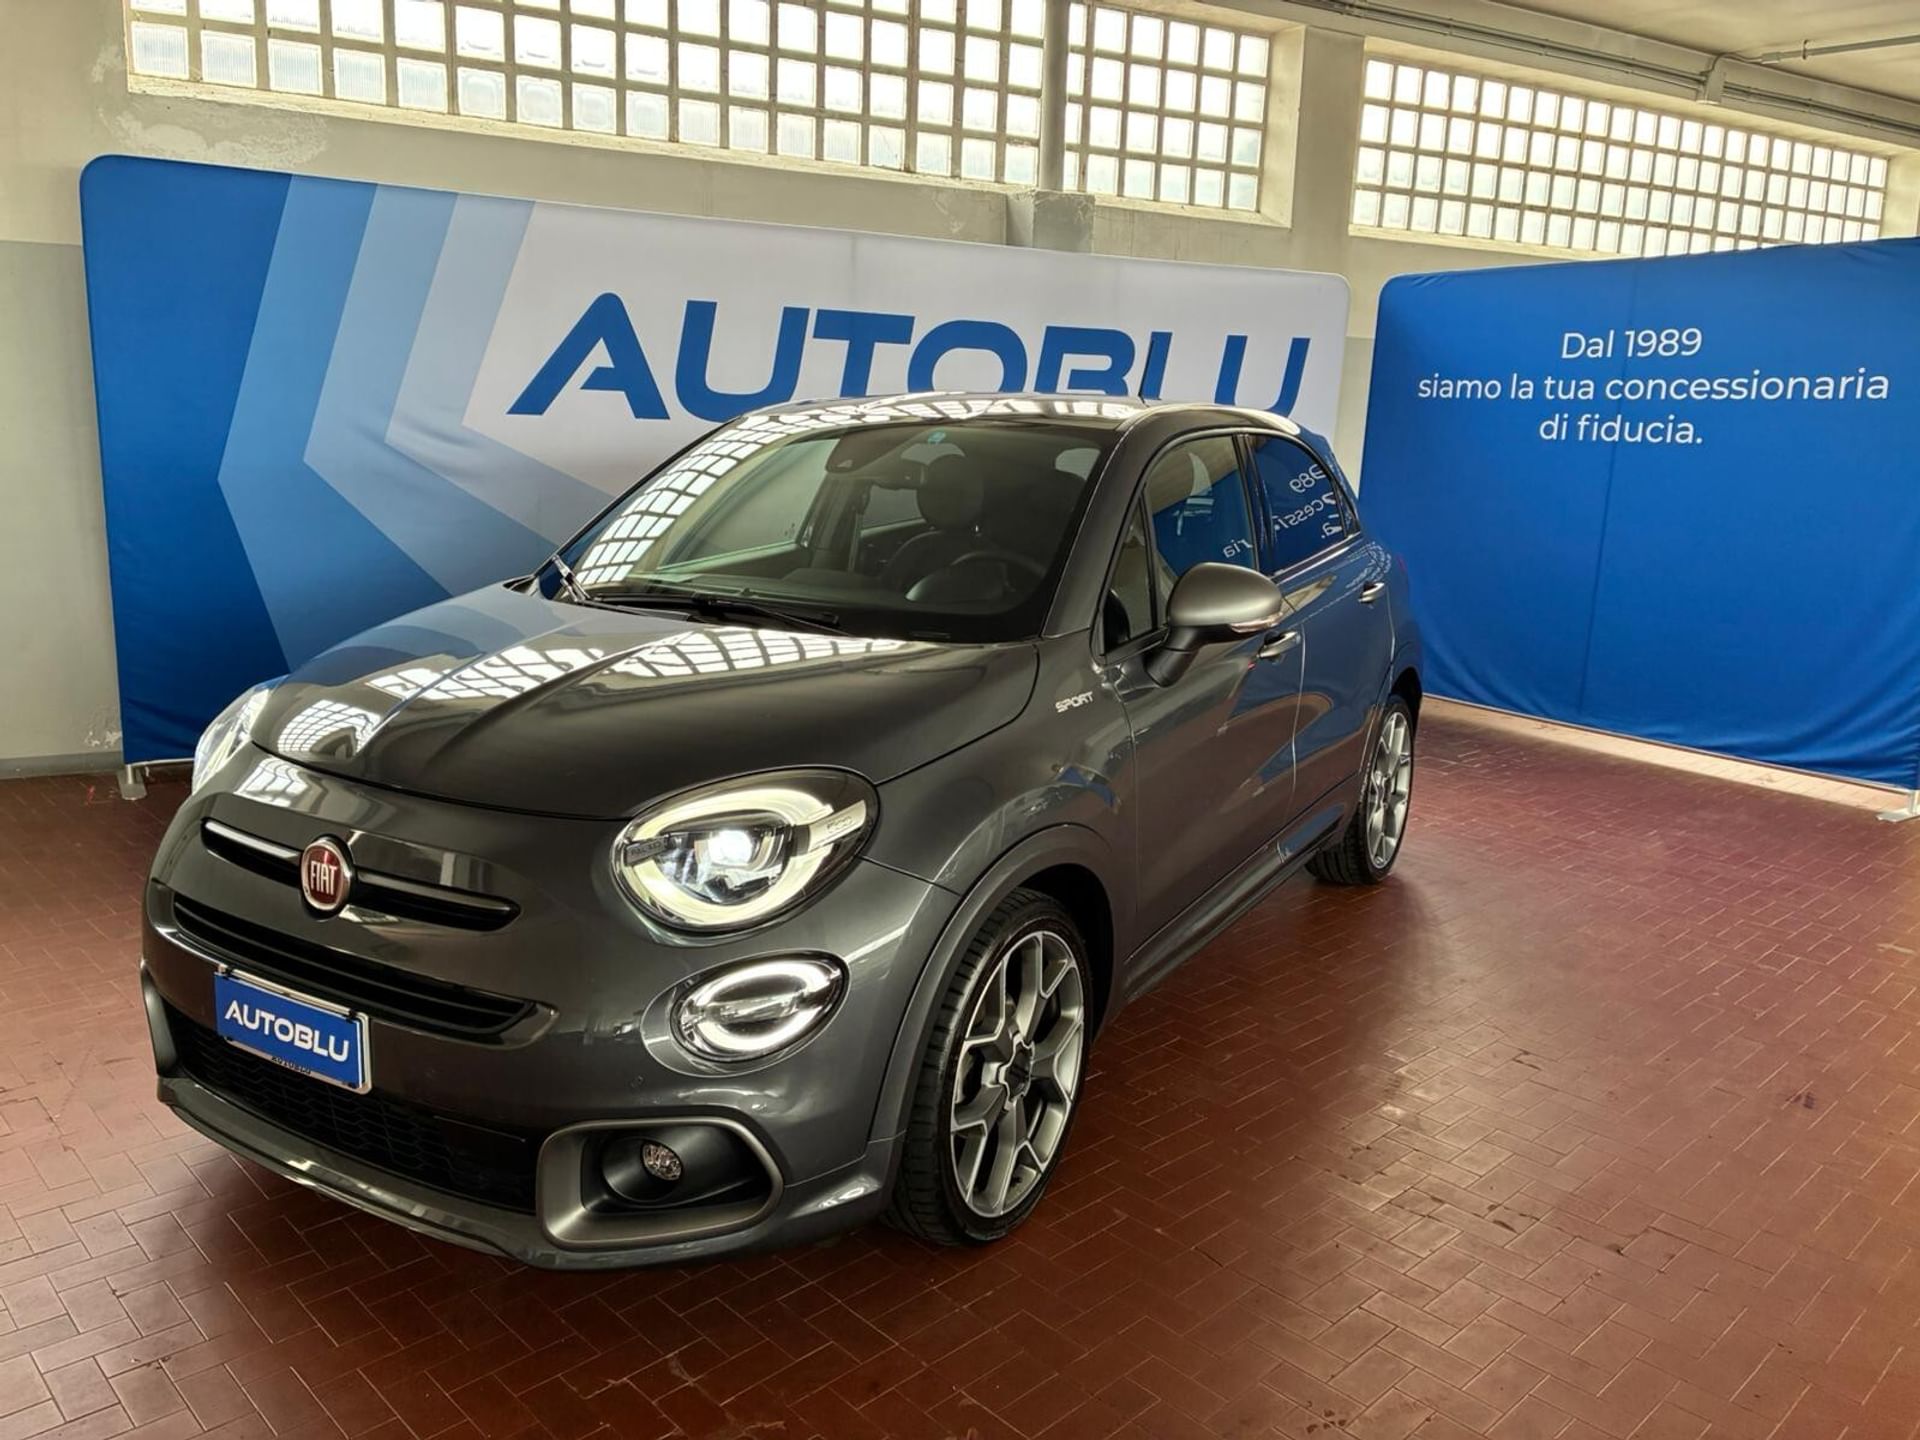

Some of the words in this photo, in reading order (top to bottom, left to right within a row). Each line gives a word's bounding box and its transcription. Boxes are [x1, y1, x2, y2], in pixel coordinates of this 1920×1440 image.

[506, 292, 1311, 421] AUTOBLU
[1561, 330, 1614, 359] Dal
[1624, 327, 1703, 357] 1989
[1418, 373, 1502, 399] siamo
[1510, 373, 1535, 400] la
[1544, 375, 1595, 400] tua
[1605, 367, 1890, 401] concessionaria
[1539, 413, 1567, 440] di
[1578, 414, 1704, 445] fiducia.
[1055, 691, 1093, 713] SPORT
[310, 860, 339, 895] FIAT
[224, 1000, 349, 1062] AUTOBLU
